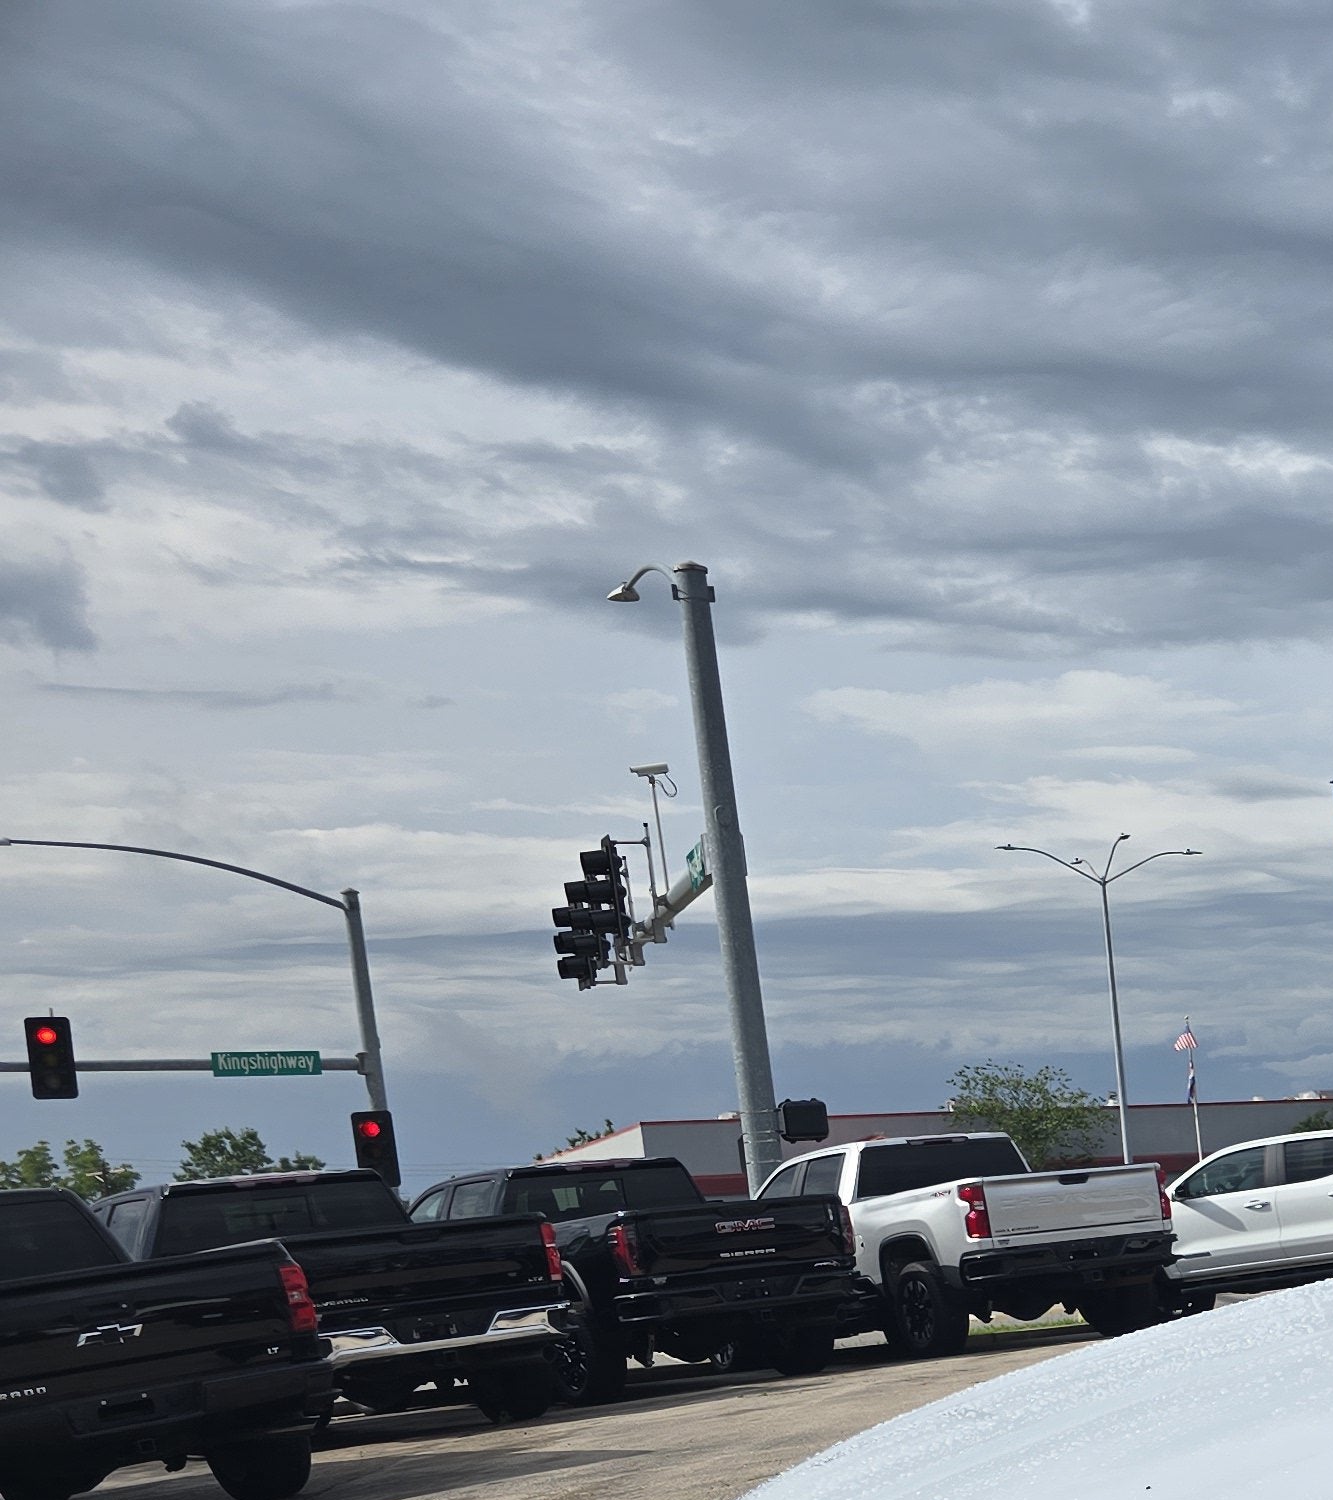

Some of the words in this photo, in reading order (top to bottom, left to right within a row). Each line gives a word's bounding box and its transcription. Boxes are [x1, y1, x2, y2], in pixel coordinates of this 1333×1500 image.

[217, 1053, 315, 1075] Kingshighway
[715, 1217, 776, 1234] GMC
[267, 1346, 279, 1355] LT
